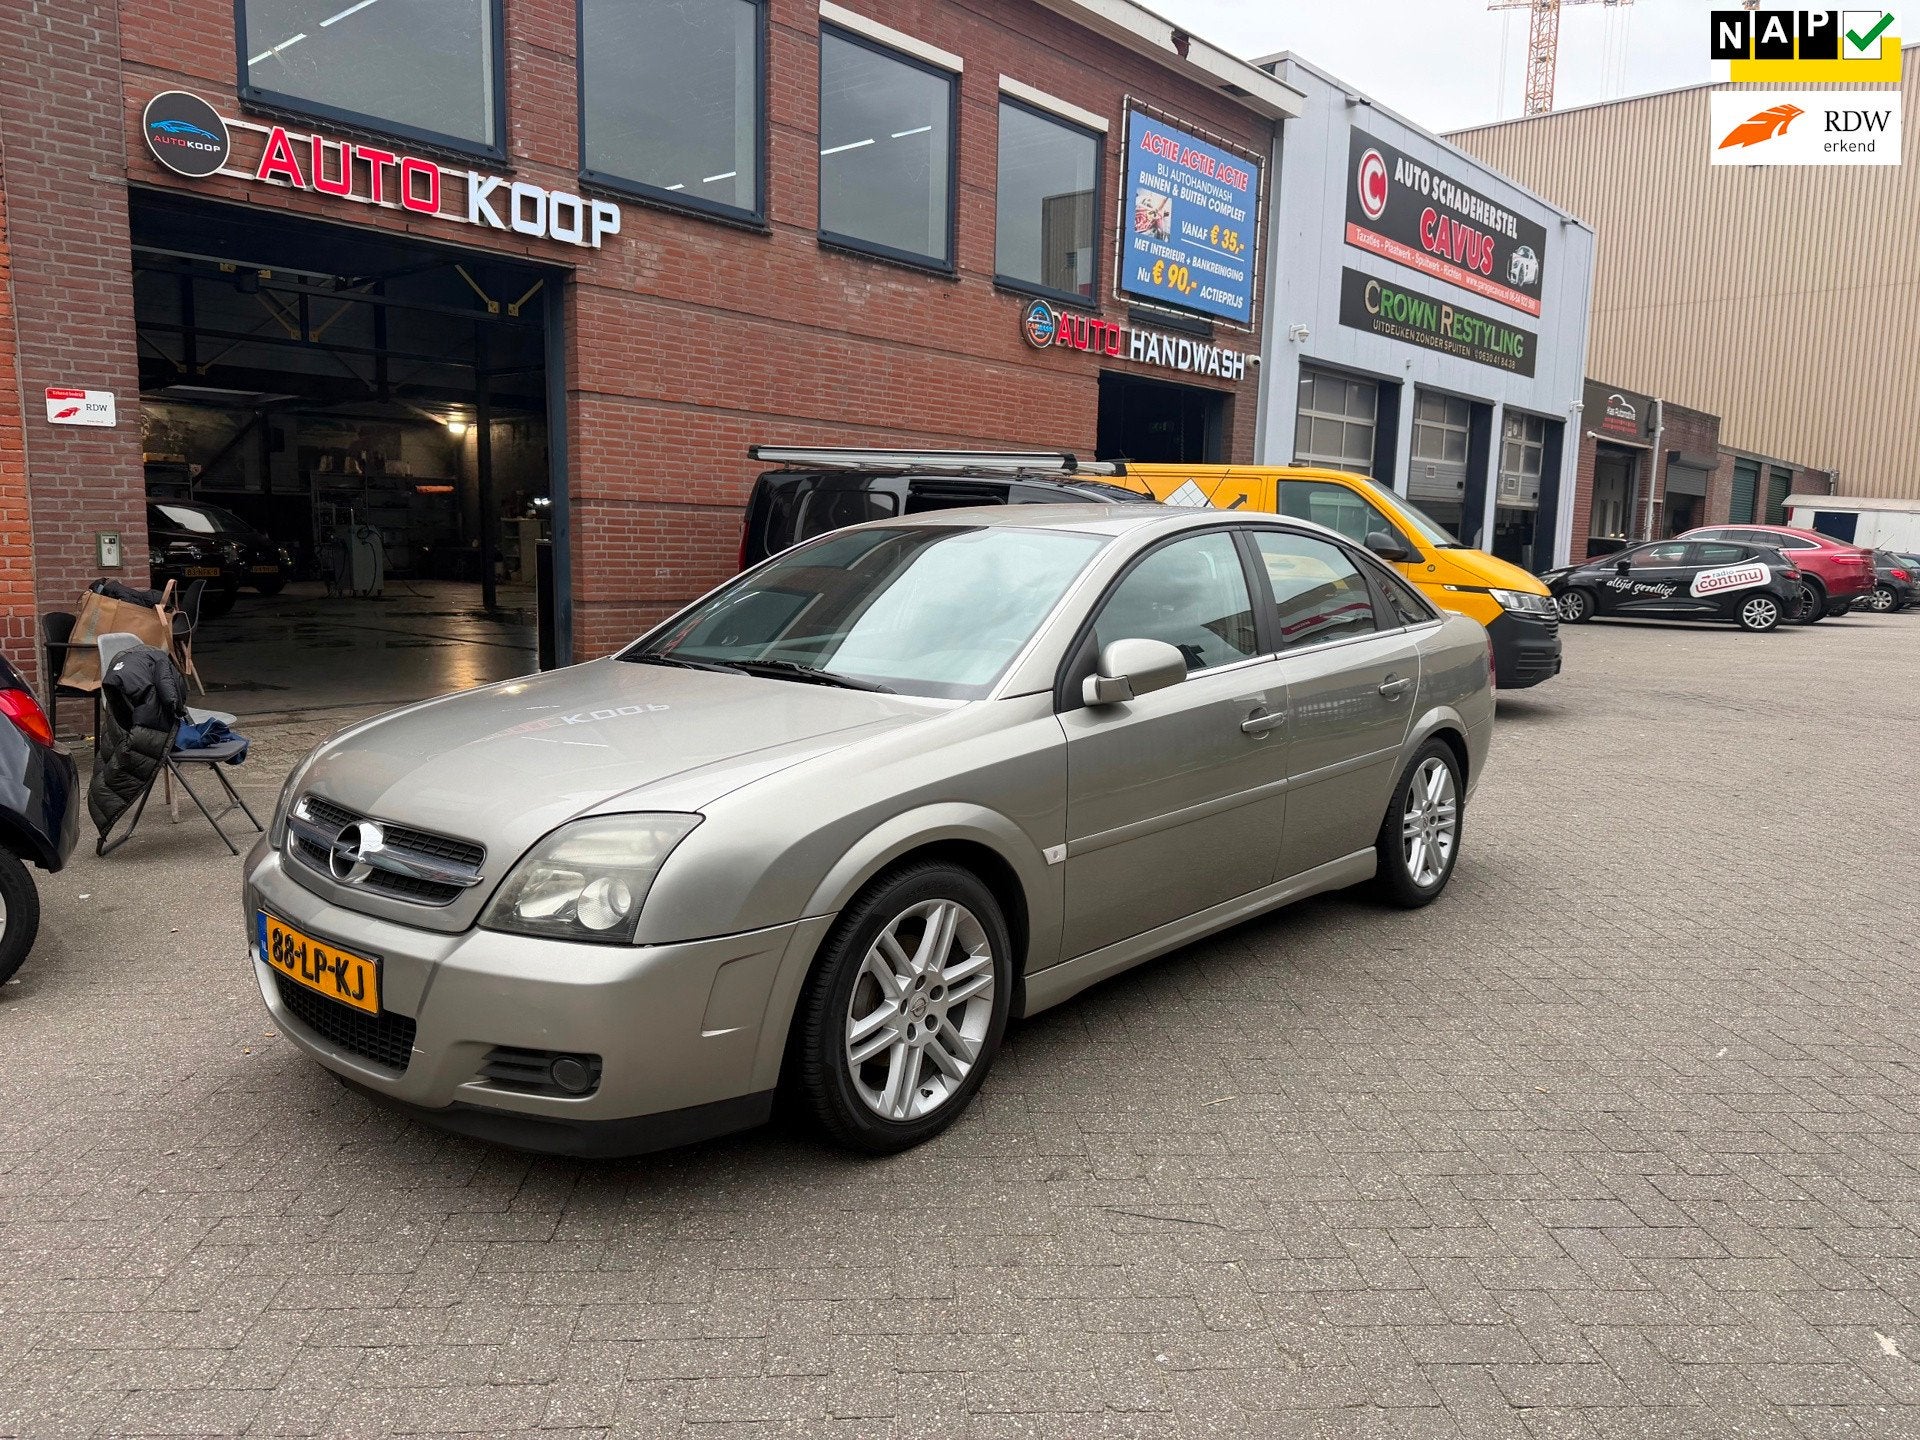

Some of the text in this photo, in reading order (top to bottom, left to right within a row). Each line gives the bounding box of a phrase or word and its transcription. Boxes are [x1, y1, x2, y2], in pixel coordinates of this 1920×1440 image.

[153, 134, 221, 153] AUTOKOOP
[1140, 130, 1249, 192] ACTIE ACTIE ACTIE
[255, 125, 621, 248] AUTO KOOP
[1139, 171, 1170, 193] BINNEN
[1180, 187, 1207, 207] BUITEN
[1208, 199, 1246, 223] COMPLEET
[1157, 163, 1233, 203] BIJ AUTOHANDWASH
[1394, 157, 1518, 240] AUTO SCHADEHERSTEL
[1181, 221, 1208, 241] VANAF
[1420, 207, 1496, 275] CAVUS
[1134, 238, 1149, 252] MET
[1150, 242, 1185, 264] INTERIEUR
[1191, 256, 1244, 282] BANKREINIGING
[1137, 267, 1151, 283] Nu
[1200, 285, 1243, 309] ACTIEPRIJS
[1364, 279, 1524, 359] CROWN RESTYLING
[1372, 319, 1415, 341] UITDEUKEN
[1415, 331, 1444, 349] ZONDER
[1055, 311, 1245, 381] AUTO HANDWASH
[85, 403, 108, 412] RDW
[1606, 577, 1677, 600] altijd gezellig!
[1699, 571, 1759, 590] continu
[1713, 569, 1735, 578] radio
[272, 927, 365, 1000] 88-LP-KJ
